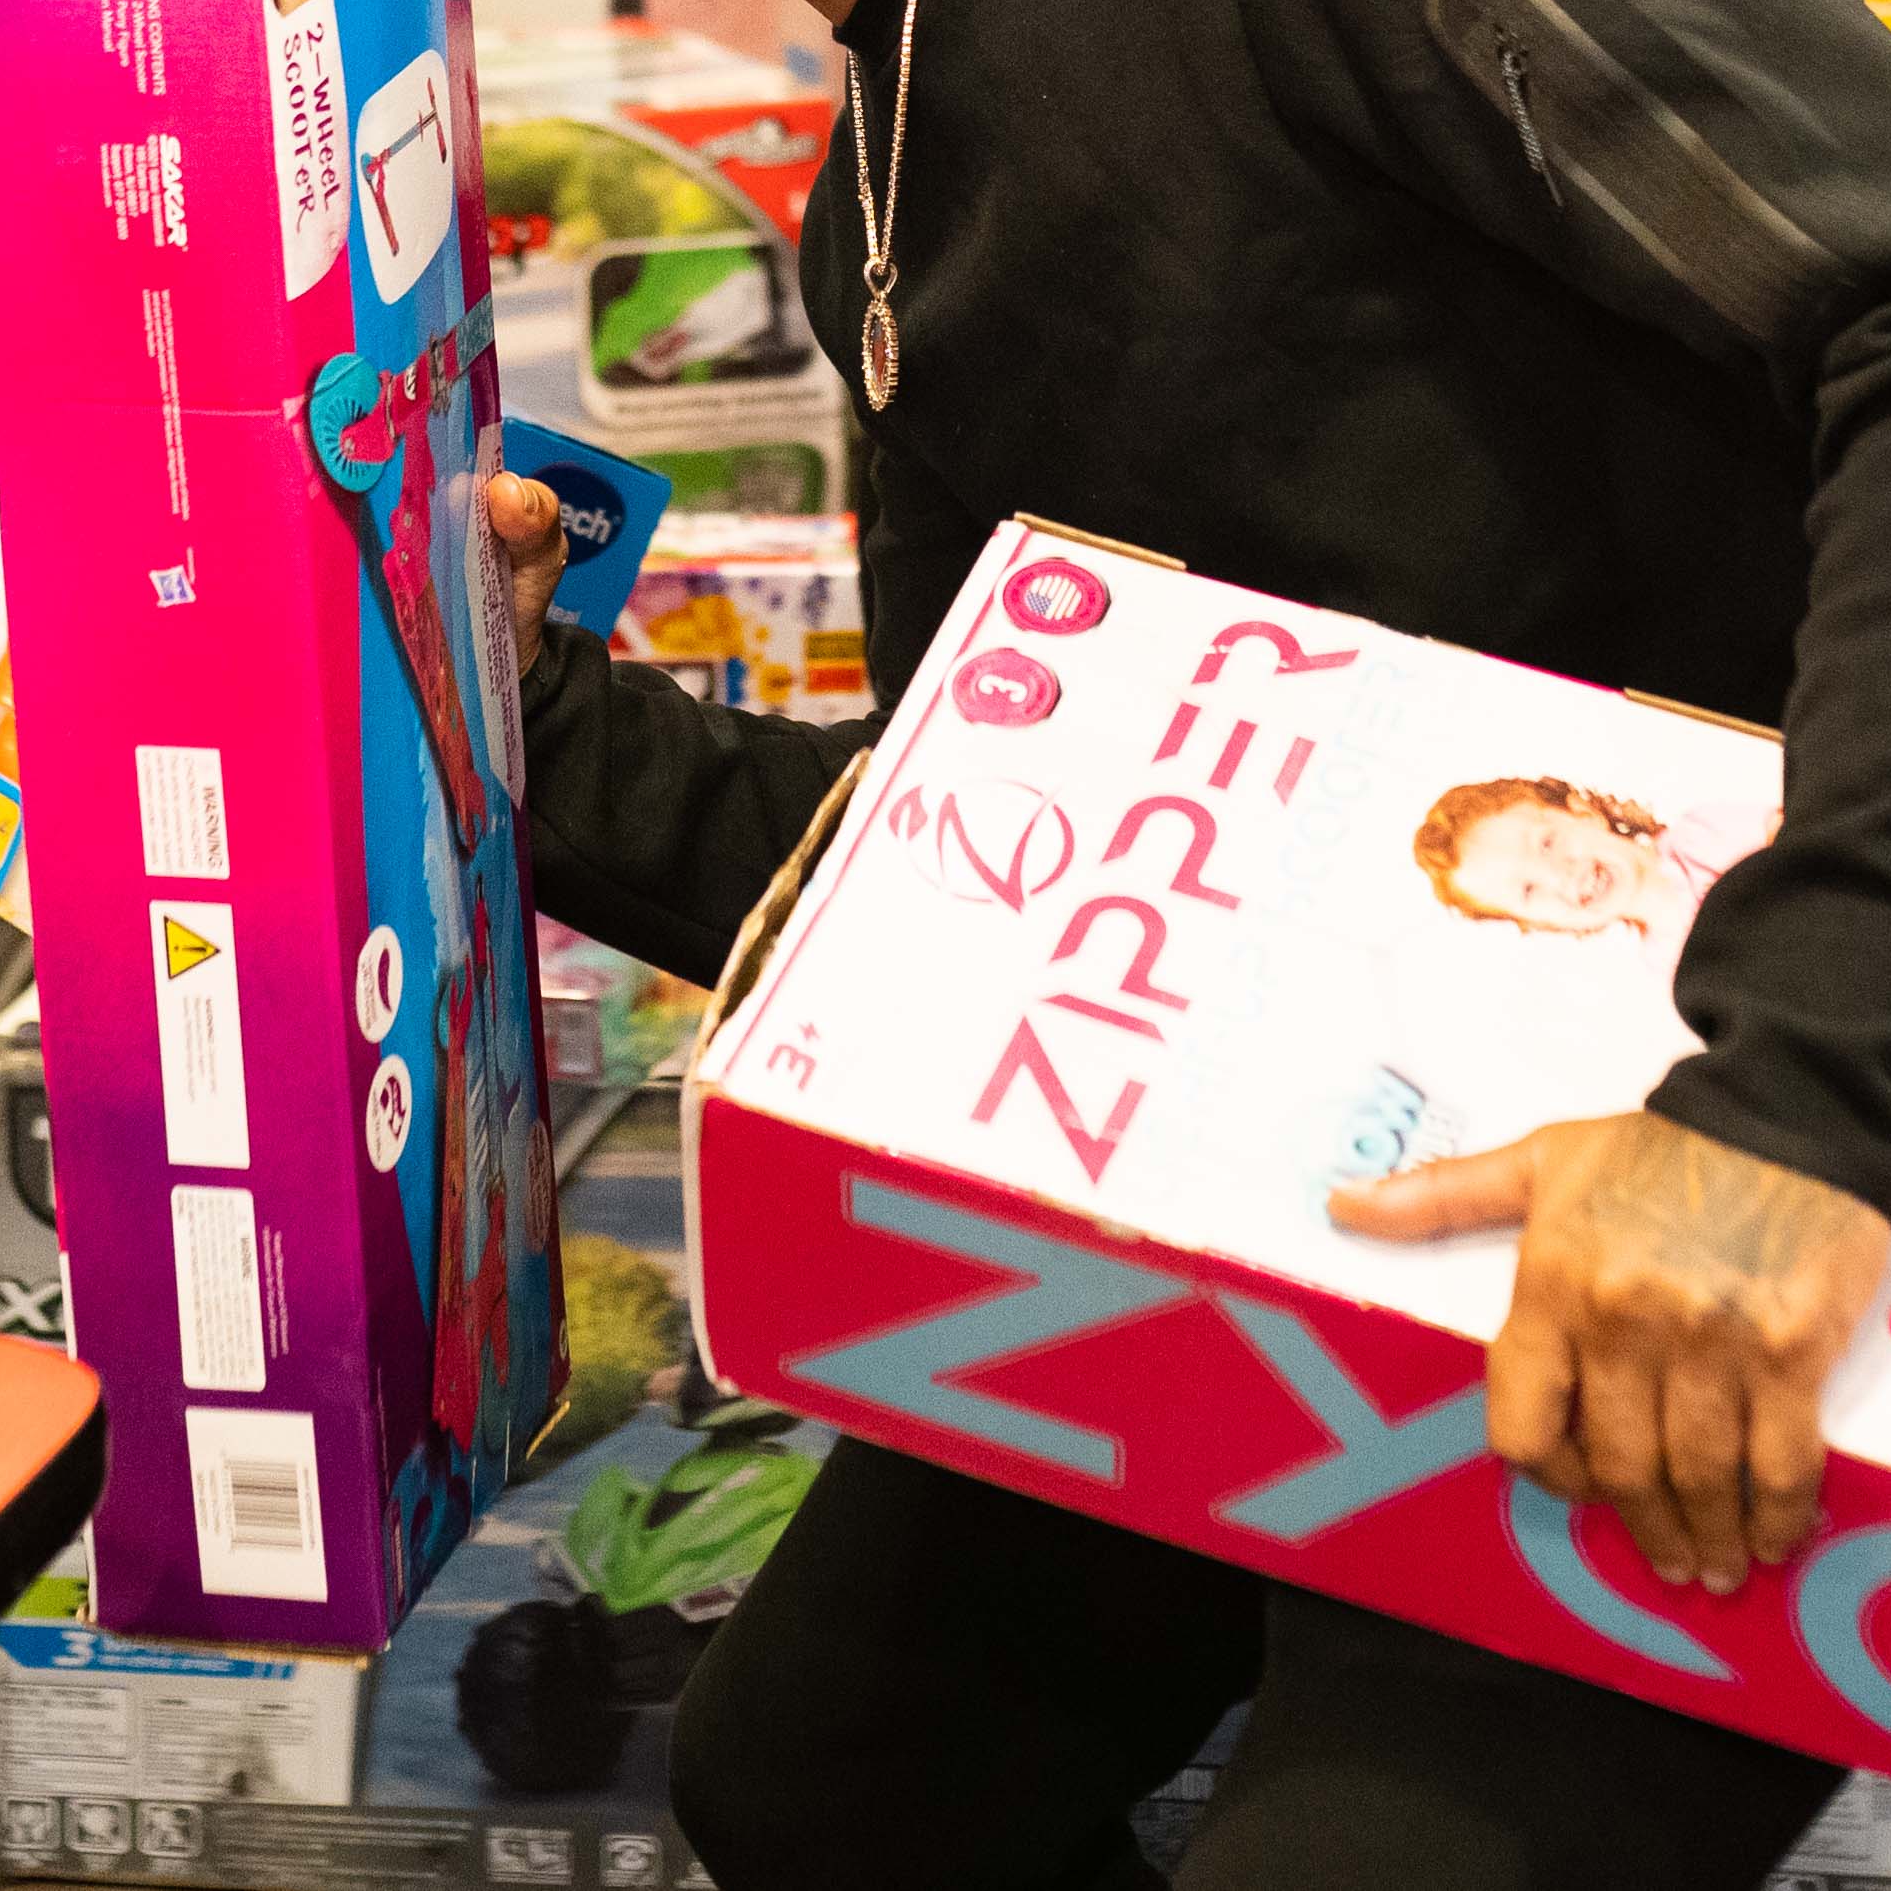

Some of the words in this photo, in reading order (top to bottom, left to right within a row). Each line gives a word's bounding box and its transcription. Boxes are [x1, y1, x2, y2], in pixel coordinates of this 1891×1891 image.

[148, 21, 166, 95] CONTENTS
[160, 134, 187, 245] SAKAR
[559, 501, 613, 544] ech
[971, 620, 1360, 1184] ZIPPER
